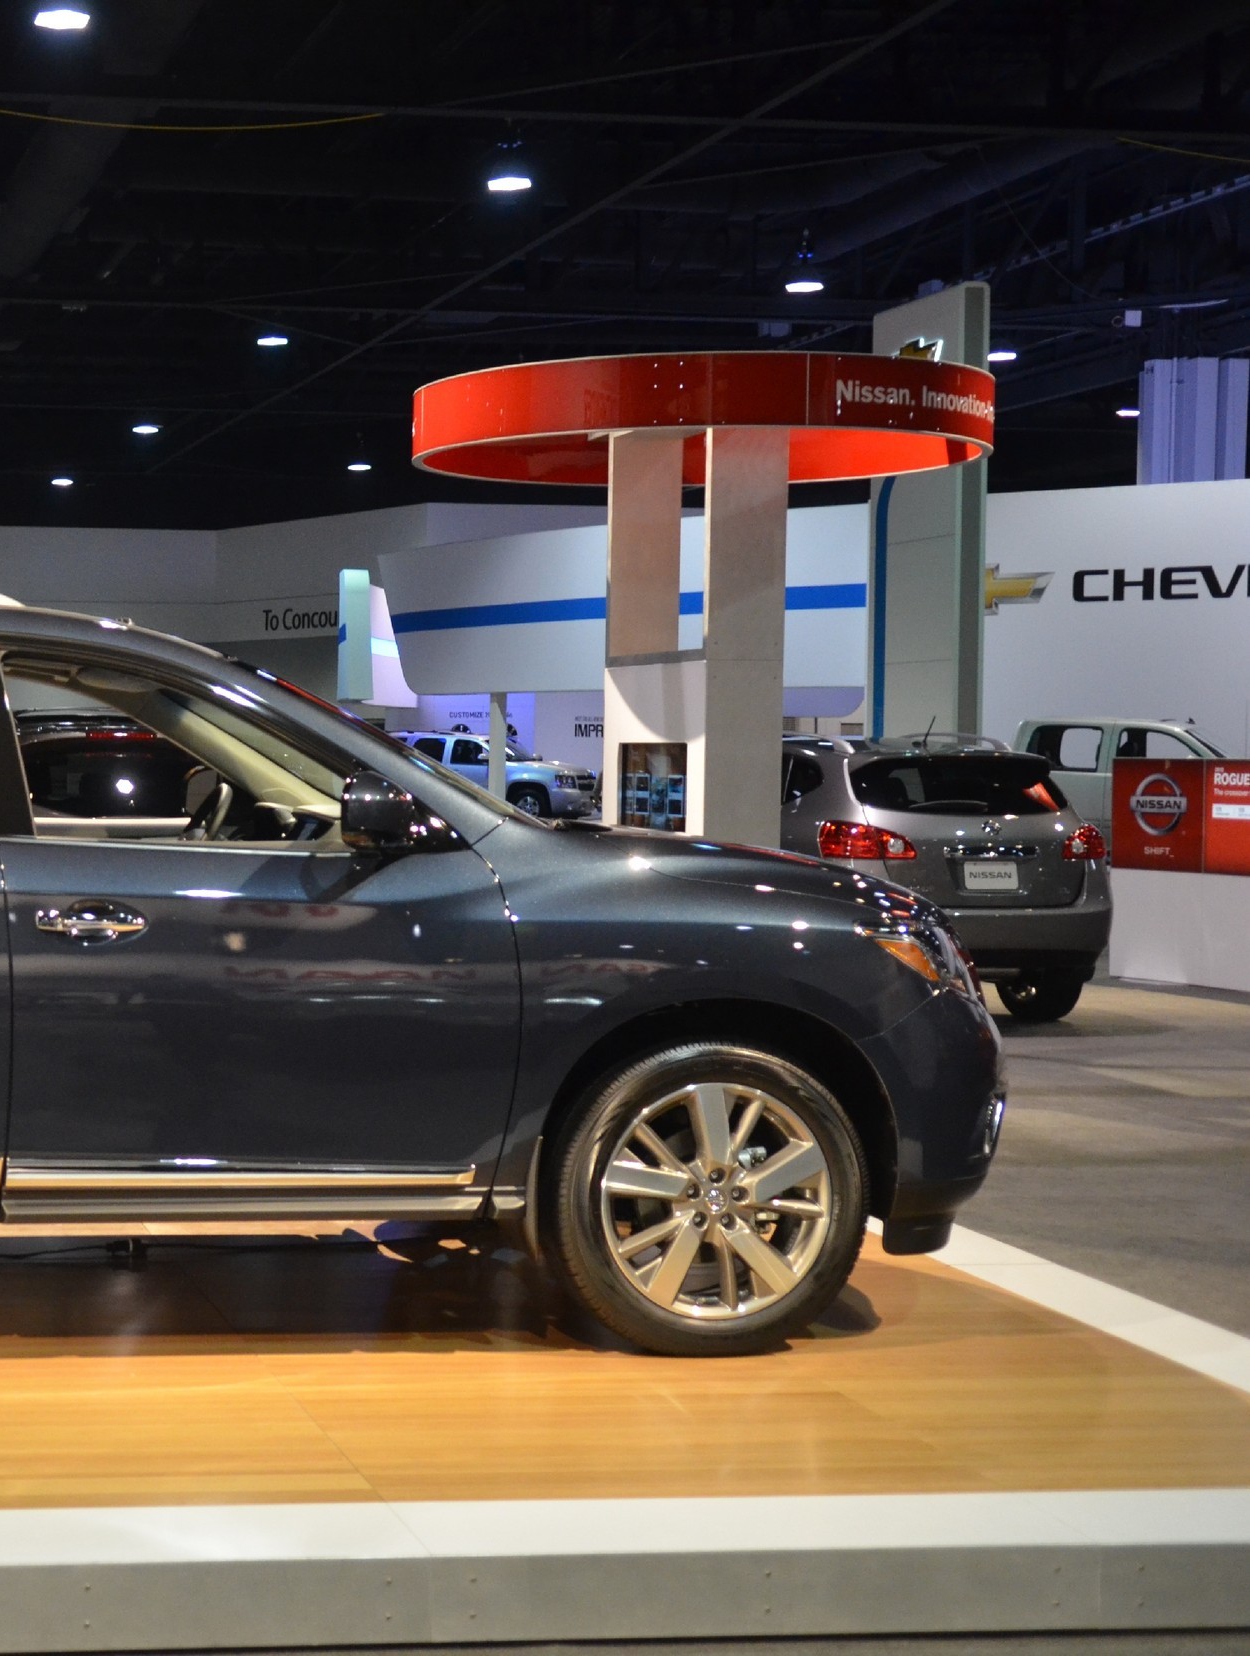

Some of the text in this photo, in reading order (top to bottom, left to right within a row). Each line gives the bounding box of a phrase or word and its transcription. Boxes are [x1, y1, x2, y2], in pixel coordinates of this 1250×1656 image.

[836, 379, 915, 406] Nissan.
[1072, 564, 1250, 603] CHEV
[263, 608, 338, 631] To Concou
[448, 711, 483, 719] CUSTOMIZE
[574, 723, 604, 738] IMPR
[1214, 772, 1250, 786] ROGUE
[1135, 799, 1182, 810] NISSAN
[969, 871, 1012, 879] NISSAN
